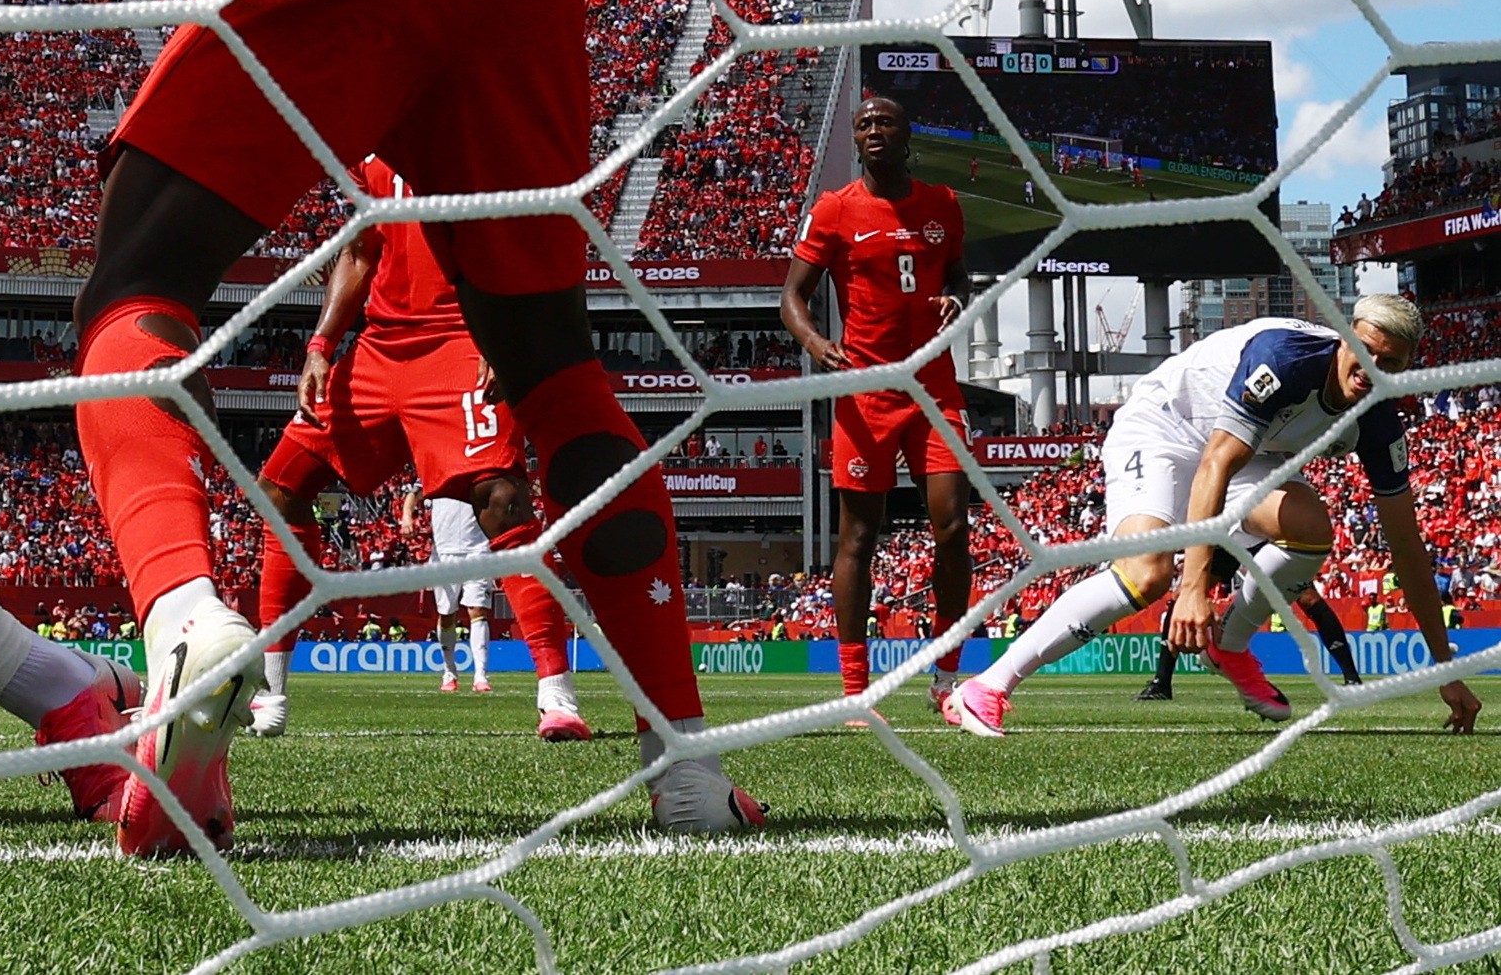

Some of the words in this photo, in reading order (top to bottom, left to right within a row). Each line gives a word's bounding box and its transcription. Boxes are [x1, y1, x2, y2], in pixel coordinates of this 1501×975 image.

[886, 54, 930, 68] 20:25
[975, 55, 998, 68] CAN
[1058, 56, 1077, 69] BIH
[1168, 160, 1199, 176] GLOBAL
[1200, 166, 1238, 181] ENERGY
[1444, 215, 1471, 237] FIFA
[645, 266, 700, 280] 2026
[898, 254, 917, 293] 8
[1036, 258, 1110, 273] Hisense
[461, 389, 498, 441] 13
[986, 443, 1026, 459] FIFA
[1124, 450, 1144, 480] 4
[700, 643, 763, 674] aramco
